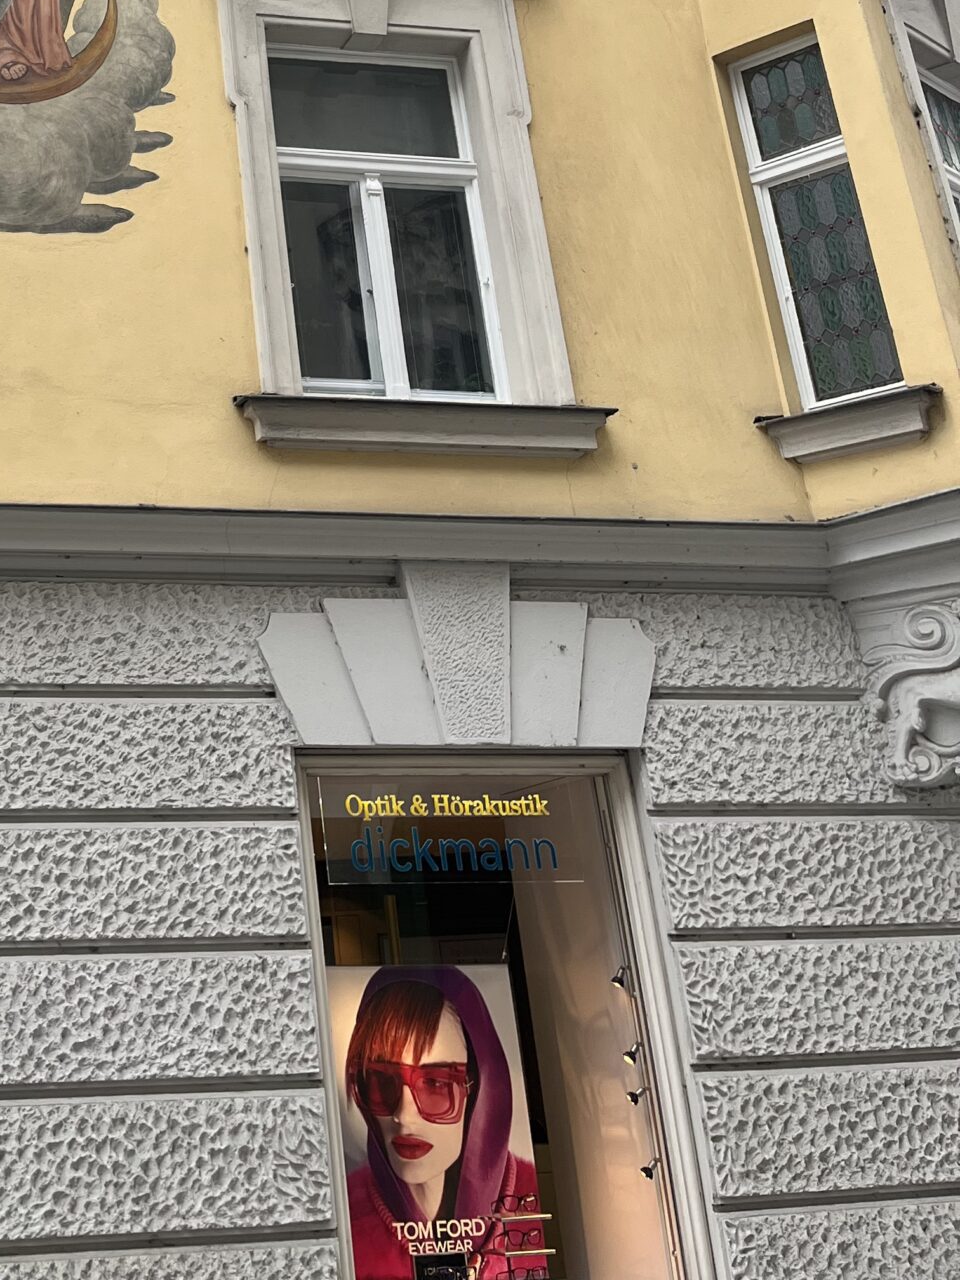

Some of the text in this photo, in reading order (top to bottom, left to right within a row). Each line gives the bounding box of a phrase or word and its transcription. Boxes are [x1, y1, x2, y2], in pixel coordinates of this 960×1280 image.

[345, 794, 550, 821] Optik & Hörakustik
[351, 826, 558, 872] dickmann
[392, 1218, 486, 1241] TOM FORD
[408, 1239, 474, 1256] EYEWEAR
